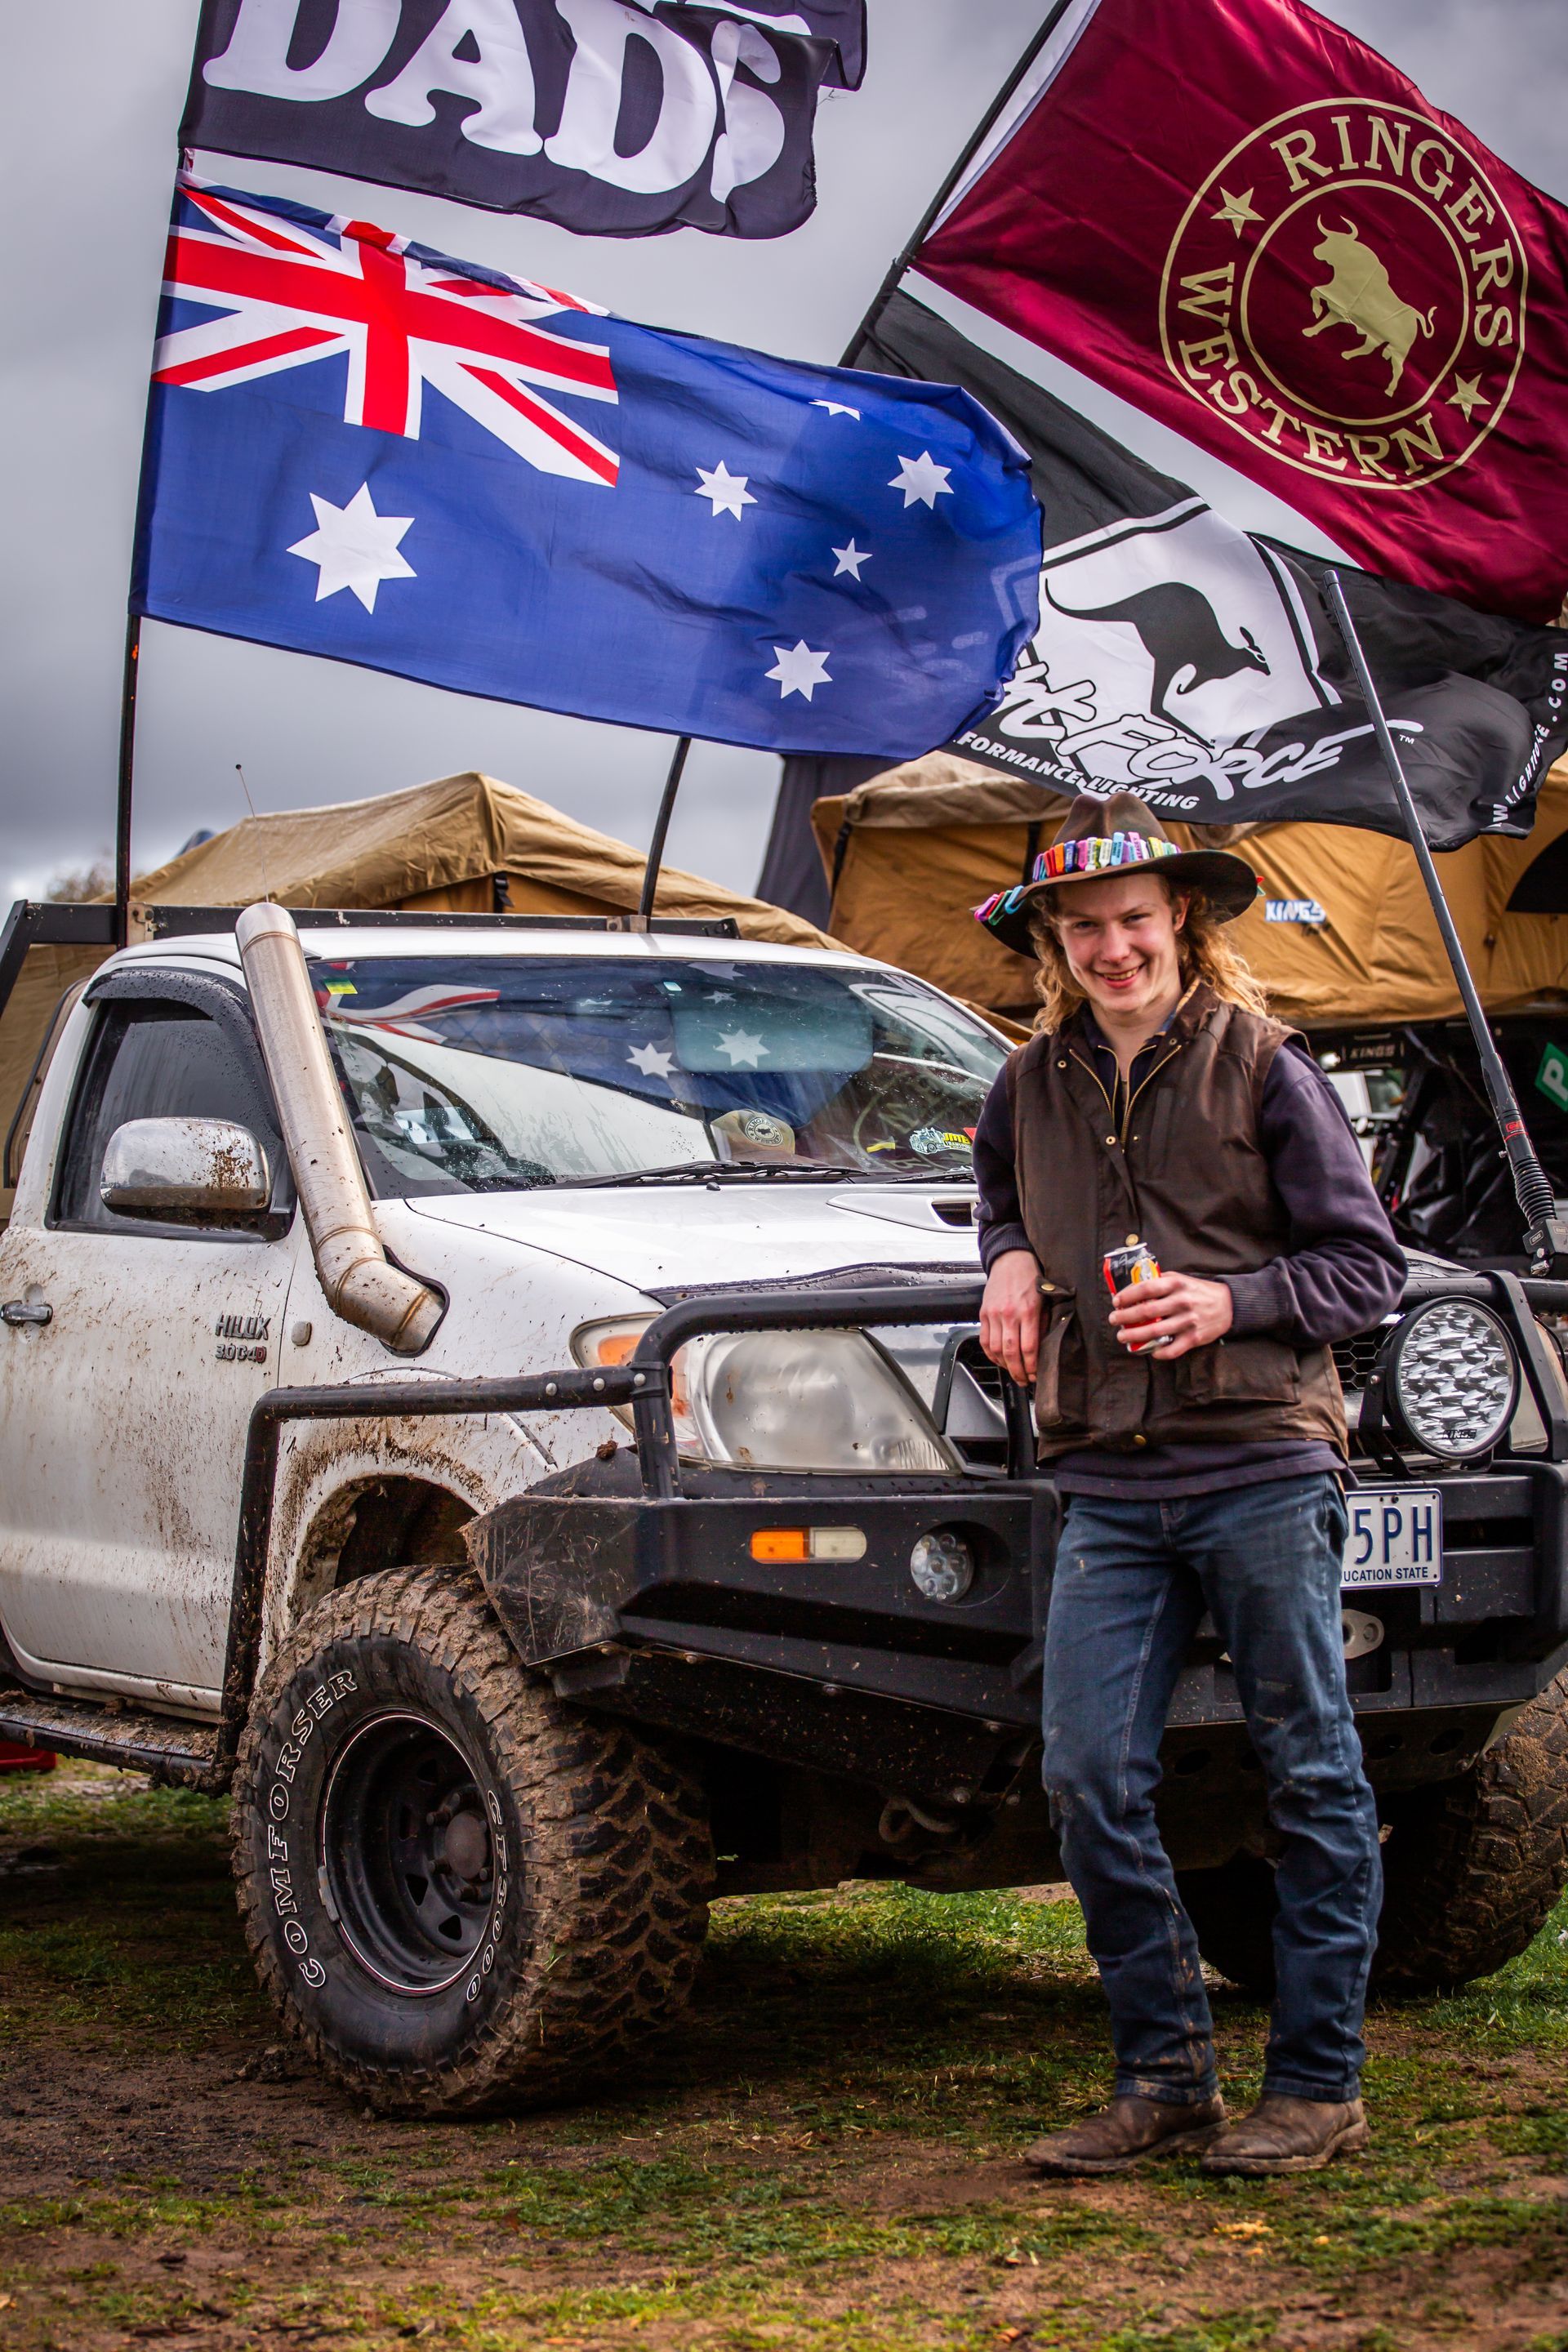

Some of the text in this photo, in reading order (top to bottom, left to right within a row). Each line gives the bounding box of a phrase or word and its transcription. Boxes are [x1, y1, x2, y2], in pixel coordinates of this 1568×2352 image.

[1269, 114, 1515, 348] RINGERS
[1177, 261, 1445, 481] WESTERN
[953, 731, 1200, 809] FORMANCE LIGHTING
[1265, 900, 1326, 922] KINGS
[215, 1313, 272, 1340] HILUX
[1353, 1504, 1432, 1564] 5PH
[1343, 1566, 1428, 1581] UCATION STATE
[268, 1670, 358, 1988] COMFORSER
